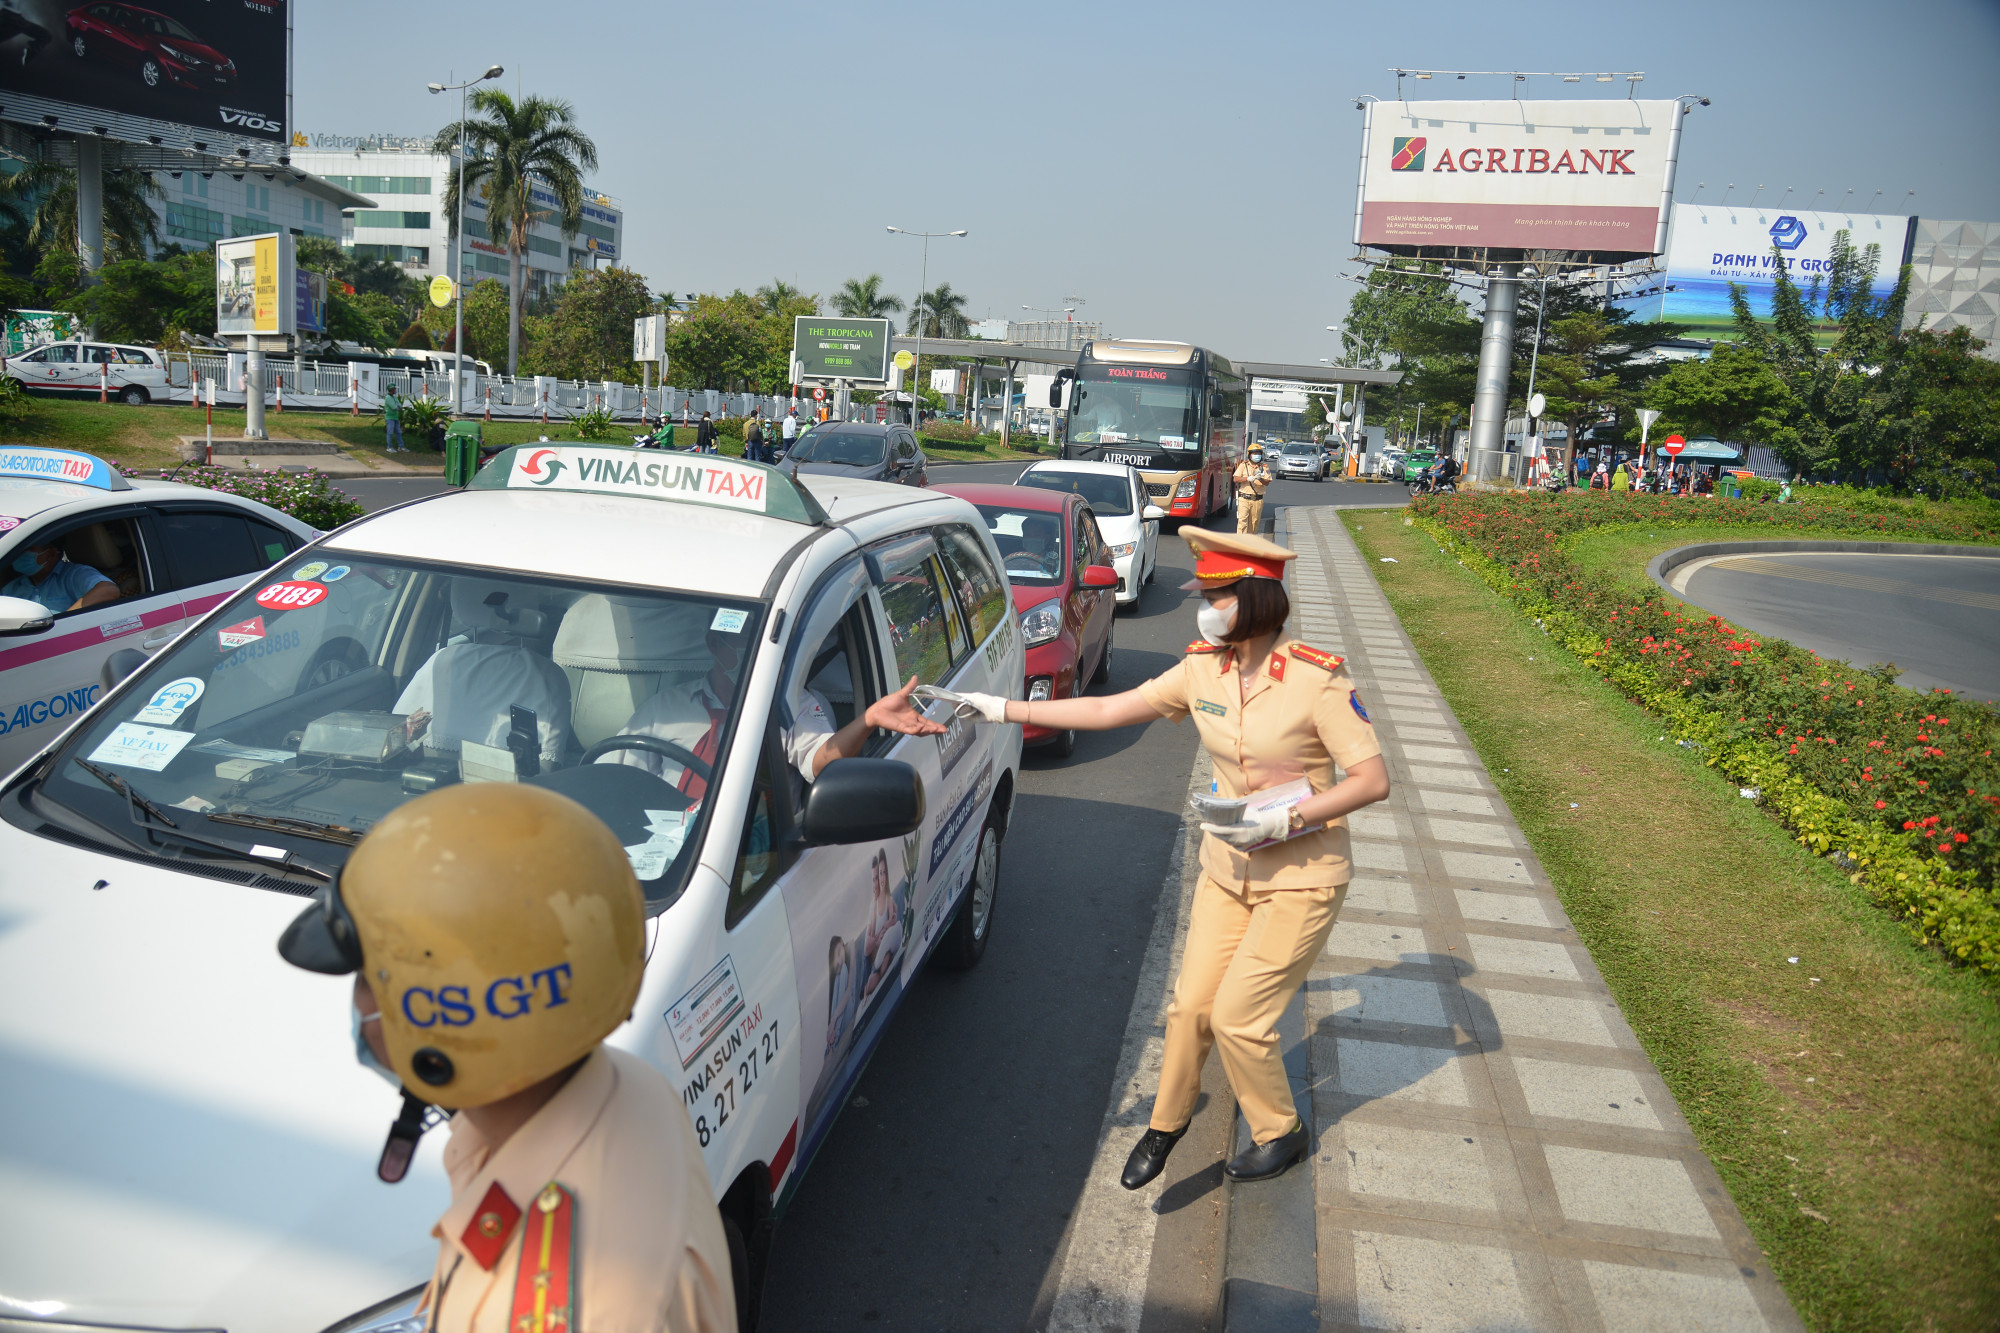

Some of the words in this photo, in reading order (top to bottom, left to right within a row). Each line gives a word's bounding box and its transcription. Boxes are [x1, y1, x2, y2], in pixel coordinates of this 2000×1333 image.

[219, 110, 282, 133] VIOS
[310, 132, 366, 148] Vietnam
[365, 133, 421, 148] Airlines
[1432, 147, 1636, 175] AGRIBANK
[1514, 218, 1534, 226] Mang
[1612, 220, 1630, 228] hàng
[1712, 252, 1757, 268] DANH
[1761, 255, 1796, 270] VIT
[1710, 266, 1728, 277] ĐẦU
[1731, 270, 1742, 278] TƯ
[1750, 270, 1766, 279] XÂY
[1804, 274, 1825, 283] PHT
[808, 327, 824, 336] THE
[827, 328, 874, 338] TROPICANA
[1108, 368, 1134, 378] TOÀN
[1134, 368, 1167, 380] THẮNG
[1102, 452, 1152, 466] AIRPORT
[258, 584, 323, 606] 8189
[138, 739, 169, 752] TAXI
[402, 962, 572, 1028] CSGT
[740, 1002, 763, 1040] TAXI
[739, 1047, 758, 1095] 27
[762, 1019, 779, 1065] 27
